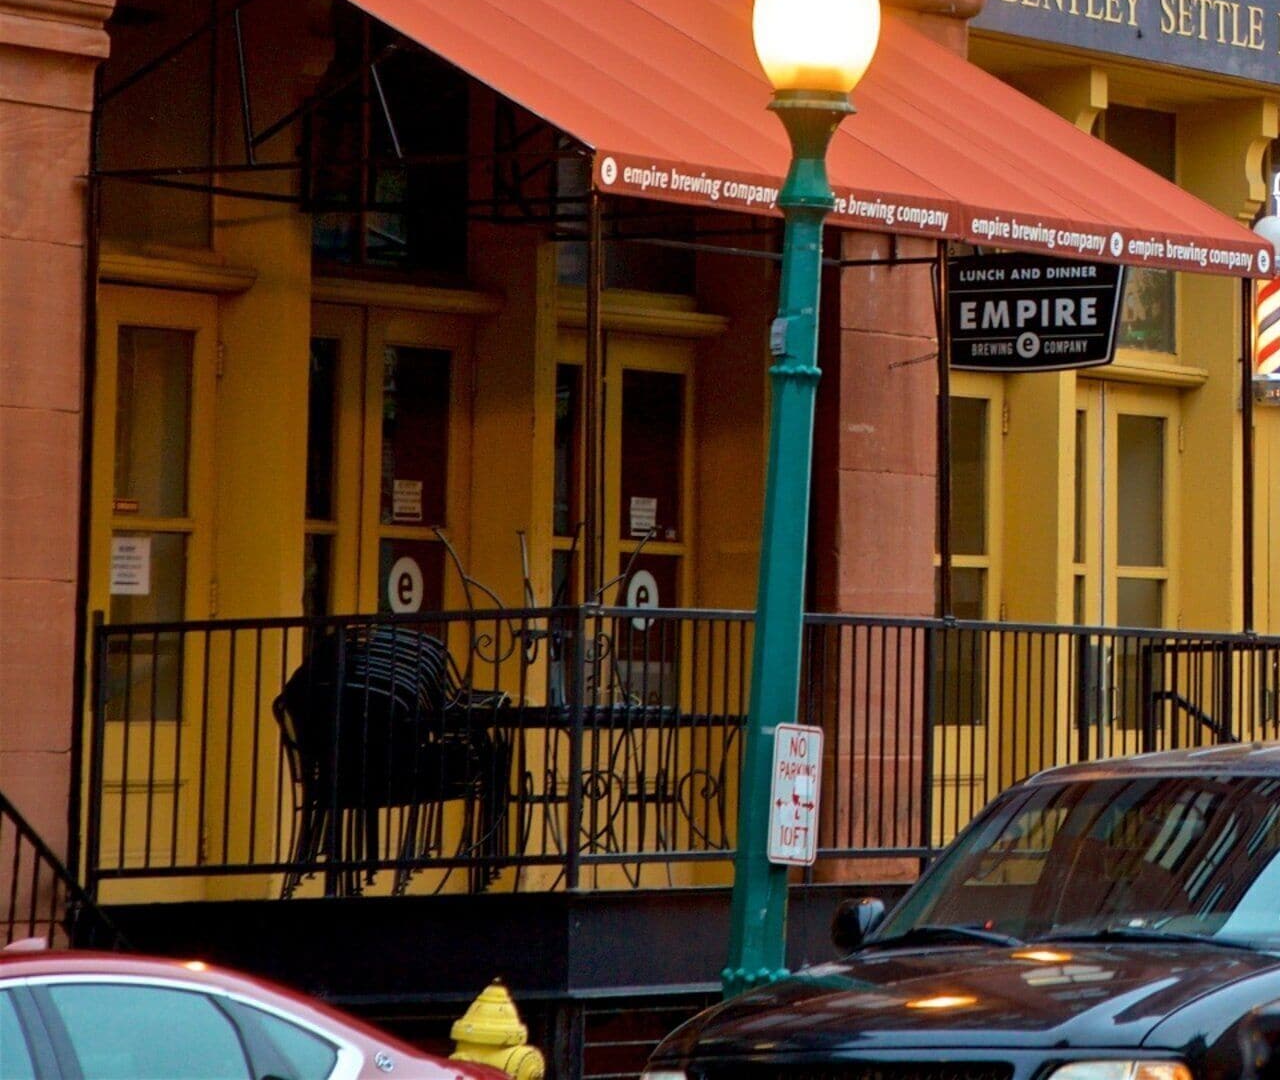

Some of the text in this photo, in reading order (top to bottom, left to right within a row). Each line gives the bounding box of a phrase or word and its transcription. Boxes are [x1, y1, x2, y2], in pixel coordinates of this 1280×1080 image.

[623, 165, 669, 191] empire
[670, 168, 722, 201] brewing
[723, 180, 779, 210] company
[847, 193, 896, 225] brewing
[896, 205, 949, 232] company
[971, 216, 1010, 240] empire
[1012, 218, 1057, 248] brewing
[1057, 230, 1107, 256] company
[1128, 237, 1164, 261] empire
[1166, 240, 1207, 267] brewing
[1209, 248, 1253, 272] company
[959, 265, 1097, 282] LUNCH AND DINNER
[959, 297, 1098, 330] EMPIRE
[971, 342, 1013, 357] BREWING
[1043, 340, 1088, 355] COMPANY
[789, 736, 807, 758] NO
